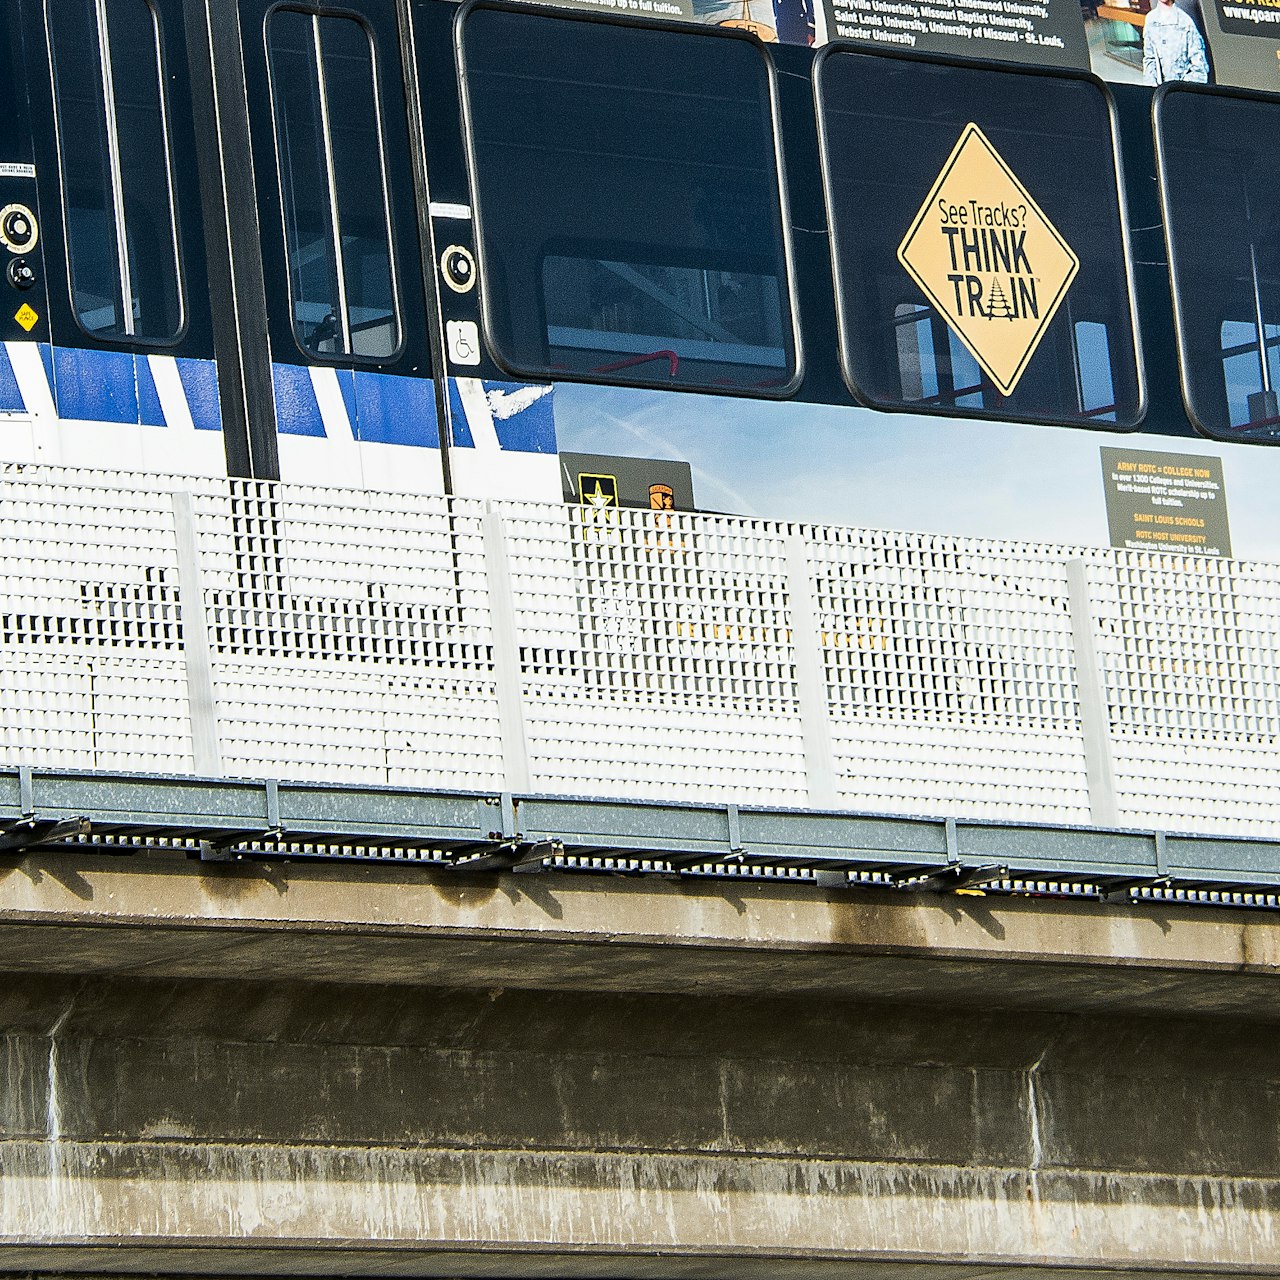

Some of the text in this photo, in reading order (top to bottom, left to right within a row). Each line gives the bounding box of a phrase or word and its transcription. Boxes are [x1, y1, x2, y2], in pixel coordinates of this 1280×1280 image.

[616, 0, 628, 9] up
[638, 0, 653, 12] full
[653, 1, 683, 15] tuition.
[920, 6, 956, 21] Missouri
[957, 10, 988, 24] Baptist
[988, 14, 1033, 31] University,
[1003, 1, 1048, 18] University,
[834, 10, 858, 23] Saint
[858, 13, 882, 26] Louis
[883, 16, 929, 33] University,
[929, 21, 972, 38] University
[973, 27, 982, 38] of
[983, 27, 1019, 42] Missouri
[1024, 32, 1038, 44] St.
[836, 25, 916, 47] Webster University
[938, 198, 1027, 228] See Tracks?
[941, 227, 1033, 274] THINK
[947, 274, 1039, 321] TRAIN
[1134, 513, 1205, 528] SAINT LOUIS SCHOOLS
[1135, 530, 1206, 544] ROTC HOST UNIVERSITY
